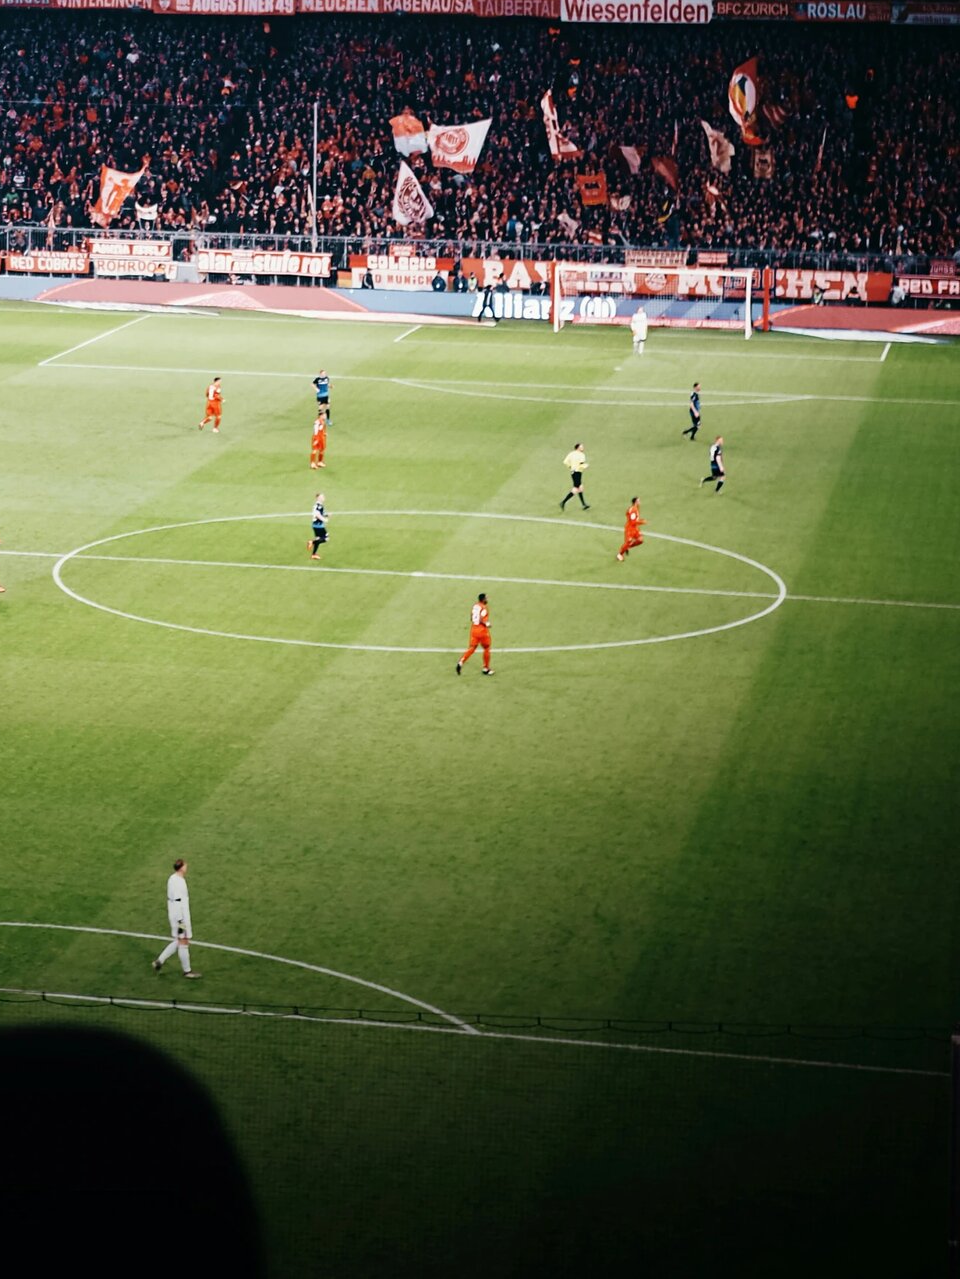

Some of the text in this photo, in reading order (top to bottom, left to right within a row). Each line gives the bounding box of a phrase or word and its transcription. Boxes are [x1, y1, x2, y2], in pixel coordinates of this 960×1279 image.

[716, 1, 741, 15] BFC
[10, 257, 85, 271] RED COBRAS
[198, 250, 300, 273] alarstufe
[301, 255, 331, 275] rot
[358, 273, 382, 284] RD
